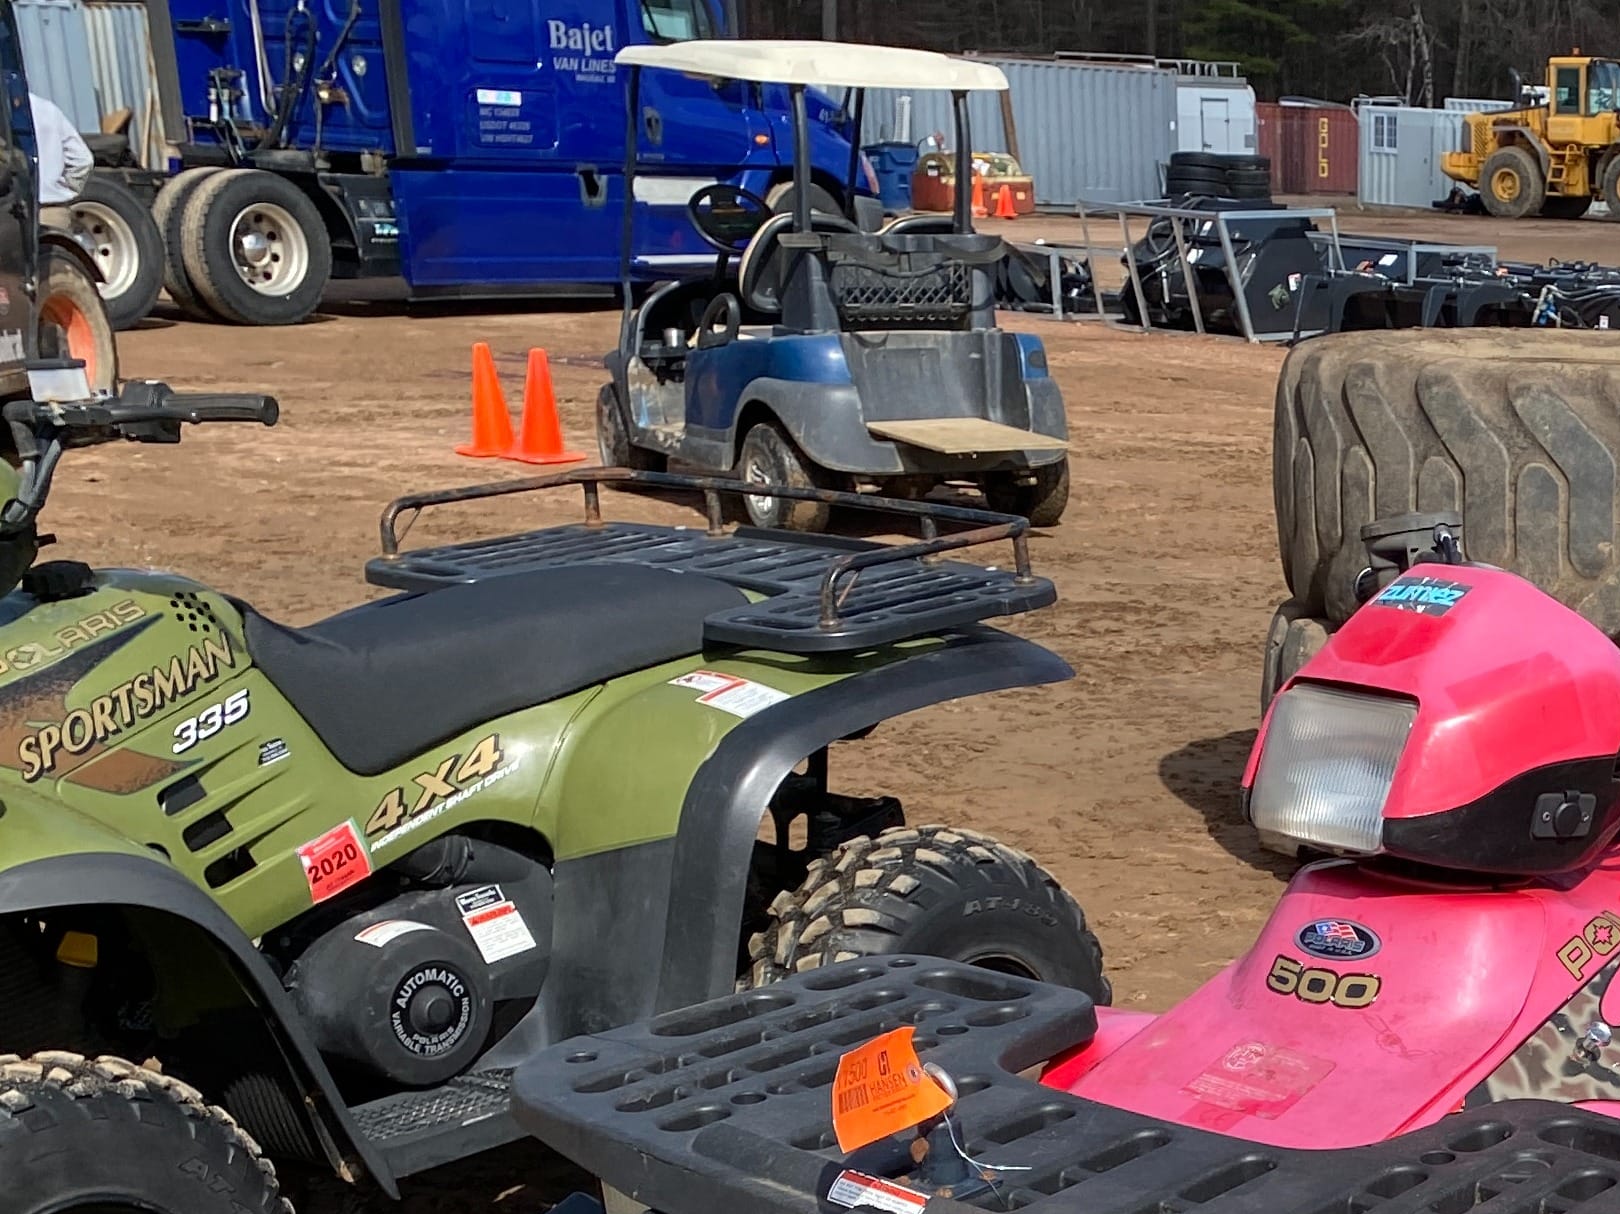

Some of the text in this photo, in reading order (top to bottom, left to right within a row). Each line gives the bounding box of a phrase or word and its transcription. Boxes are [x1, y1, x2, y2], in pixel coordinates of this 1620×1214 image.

[547, 19, 613, 56] Bajet
[553, 57, 616, 73] VAN LINES
[1319, 117, 1328, 177] GOLD
[18, 629, 236, 783] SPORTSMAN
[172, 687, 249, 754] 335
[364, 733, 504, 837] 4X4
[371, 802, 446, 853] INDEPENDENT
[446, 781, 483, 811] SHAFT
[484, 758, 521, 788] DRIVE
[308, 843, 357, 884] 2020
[1304, 931, 1366, 953] POLARIS
[396, 968, 465, 1009] AUTOMATIC
[1266, 954, 1382, 1009] 500
[392, 997, 470, 1056] VARIABLE TRANSMISSION
[869, 1070, 909, 1100] HANSEN
